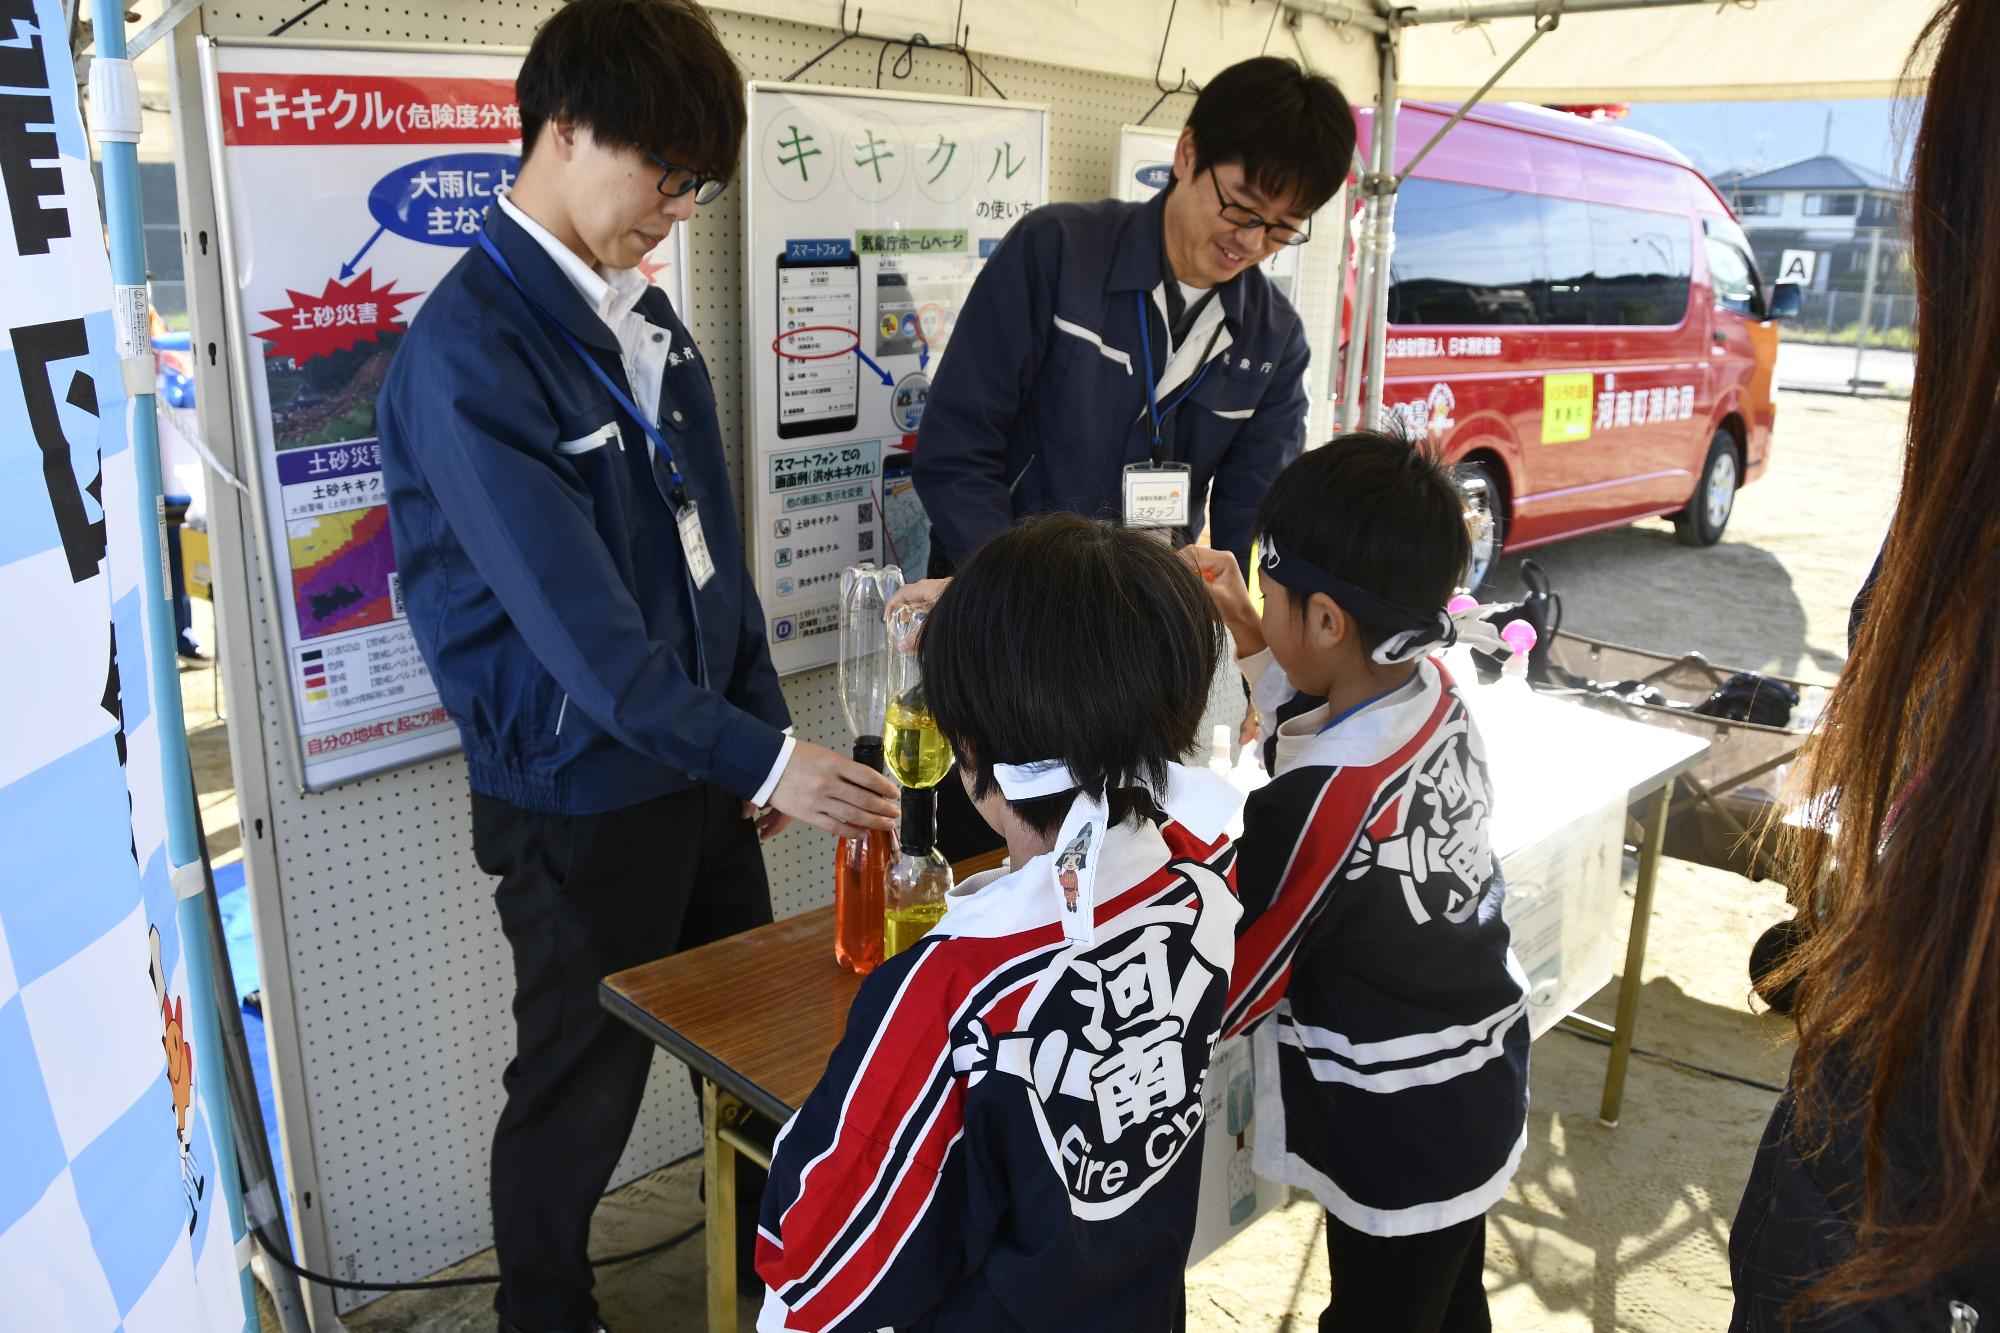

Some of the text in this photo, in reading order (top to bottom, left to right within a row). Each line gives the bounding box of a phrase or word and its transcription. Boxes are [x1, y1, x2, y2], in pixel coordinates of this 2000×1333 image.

[777, 125, 1026, 184] キキクル
[410, 169, 515, 199] 大雨によ
[427, 205, 489, 235] 主な
[976, 200, 1033, 220] の使い方
[791, 242, 845, 258] スマートフォン
[860, 234, 964, 253] 気象庁ホームページ
[1785, 257, 1806, 279] A
[291, 301, 378, 332] 土砂災害
[312, 477, 385, 501] 土砂キキク
[786, 486, 864, 508] 他の画面に表示を変更
[795, 514, 840, 530] 土砂キキクル
[1071, 924, 1186, 1145] 河南
[1060, 1123, 1129, 1195] Fire
